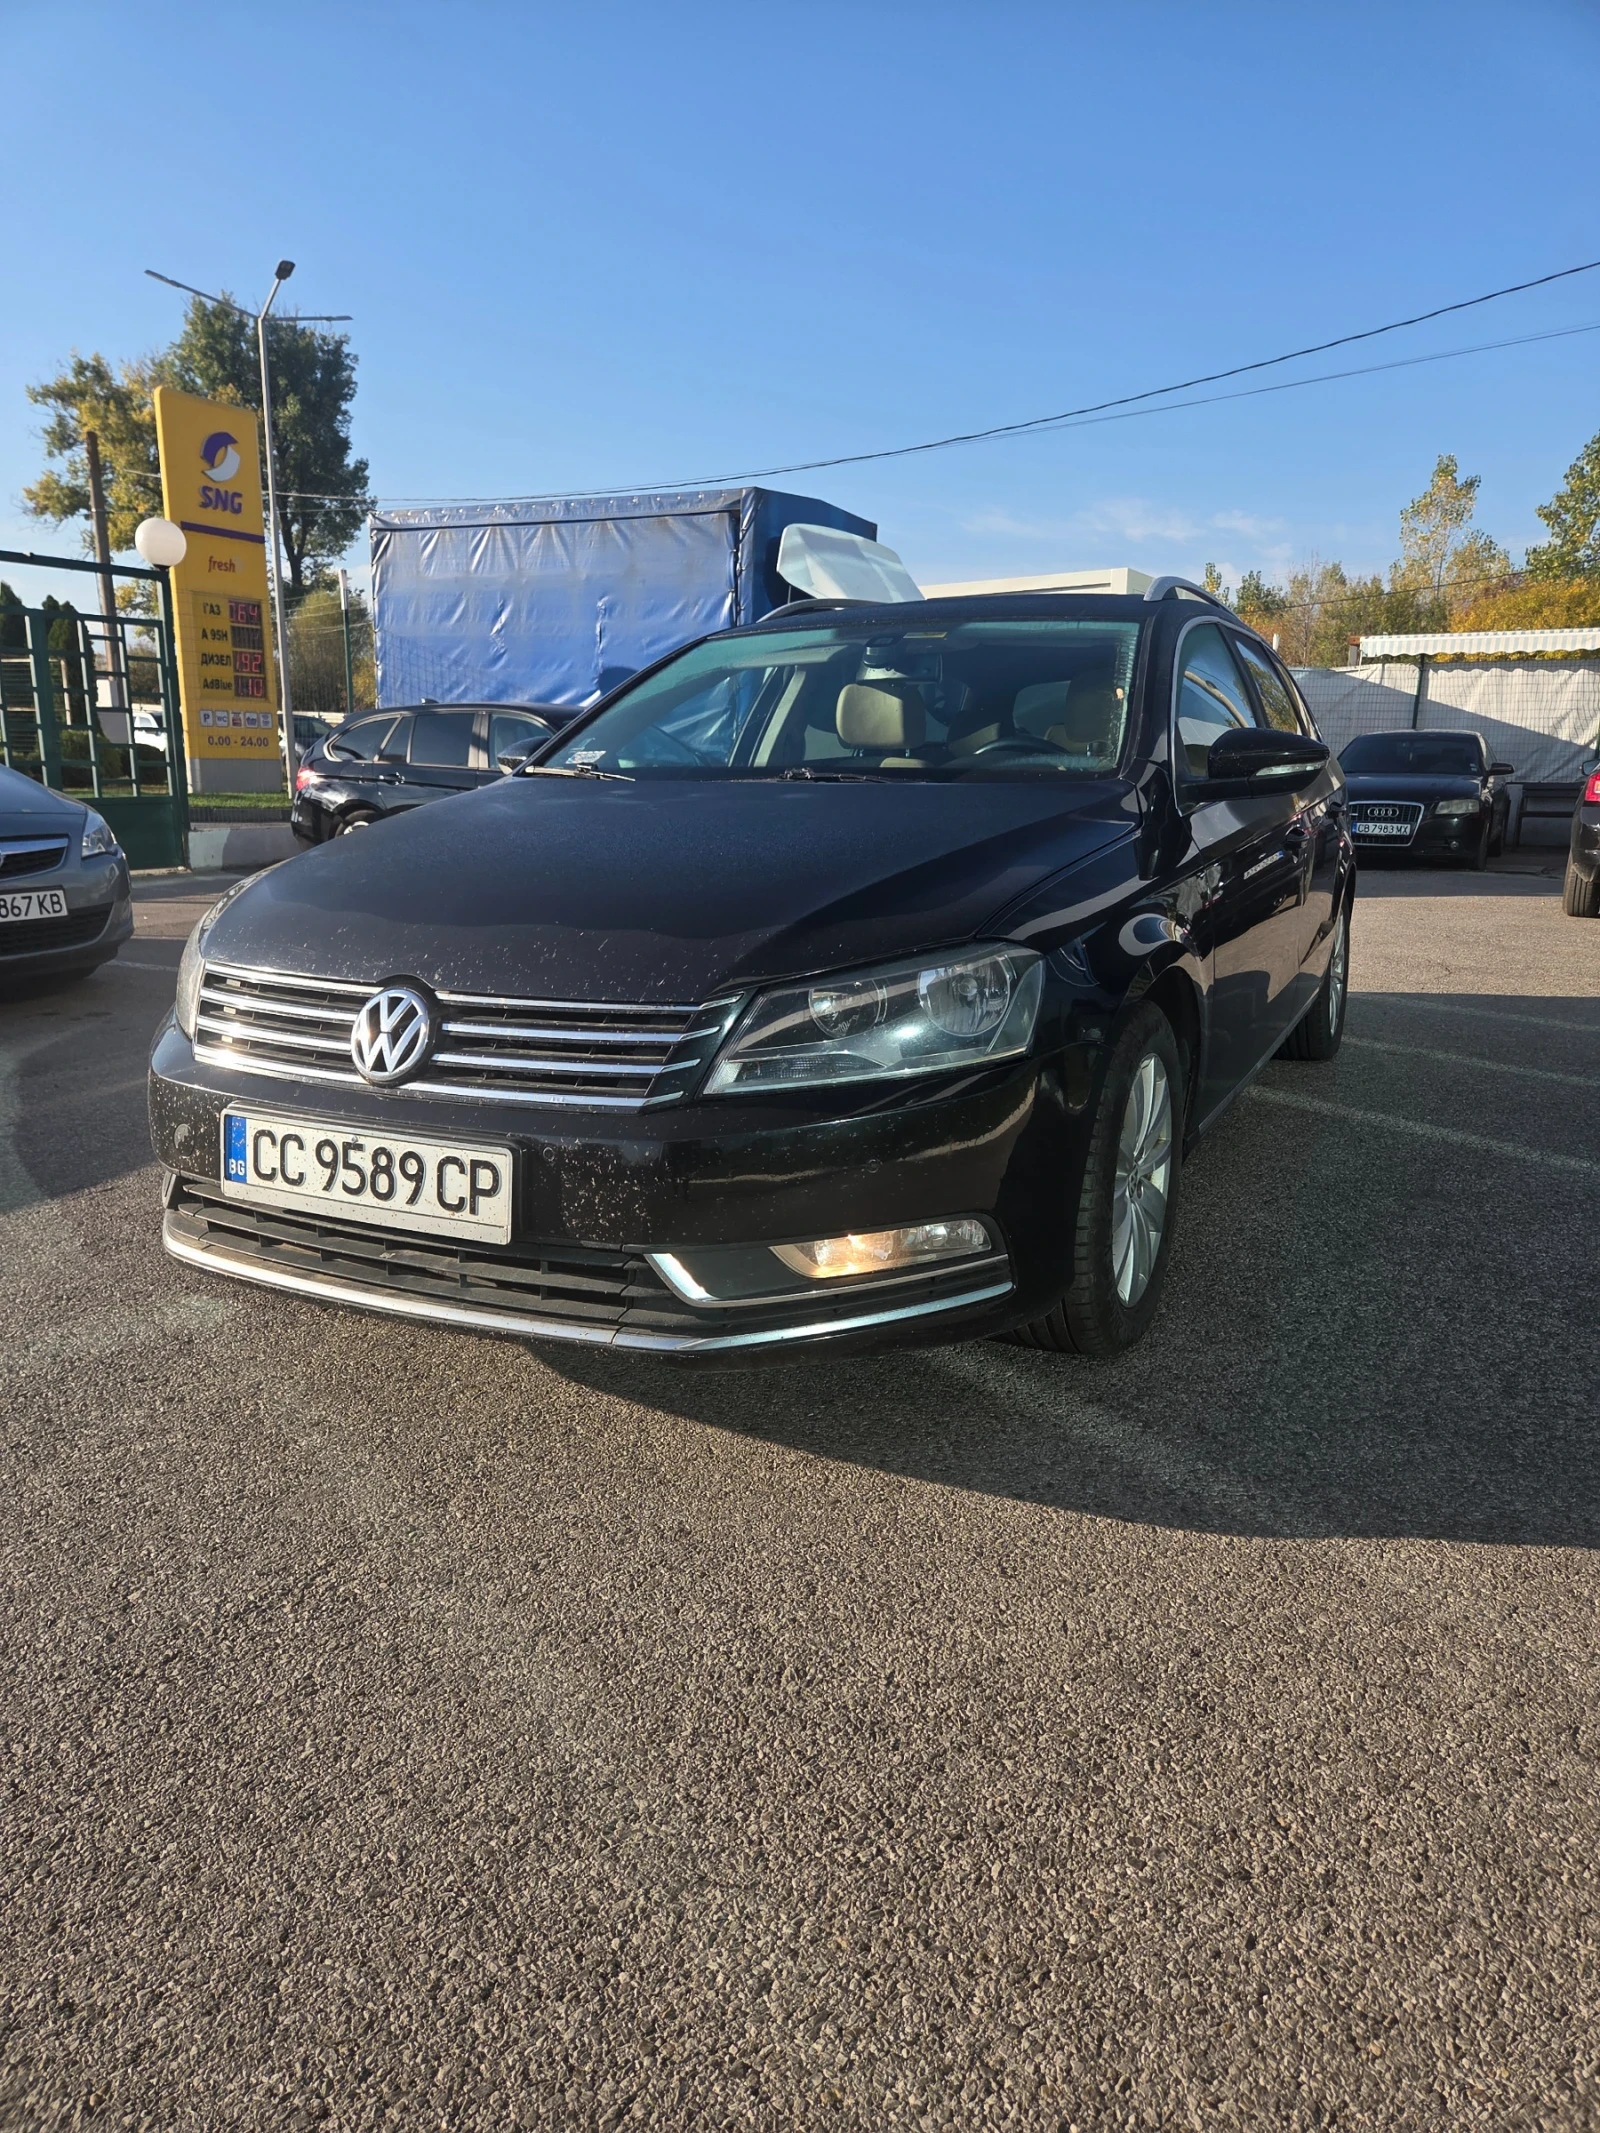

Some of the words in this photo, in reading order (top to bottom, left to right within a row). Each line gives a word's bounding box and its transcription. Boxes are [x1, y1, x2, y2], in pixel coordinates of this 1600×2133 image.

[199, 485, 243, 514] SNG
[208, 555, 236, 573] fresh
[203, 602, 221, 616] ГАЗ
[201, 653, 231, 667] ДИЗЕЛ
[203, 678, 232, 691] AdBlue
[207, 736, 231, 746] 0.00
[241, 736, 269, 747] 24.00
[1372, 824, 1395, 834] 7983
[37, 893, 63, 915] KB
[229, 1158, 245, 1176] BG
[252, 1129, 305, 1186] CC
[315, 1138, 426, 1206] 9589
[436, 1155, 501, 1215] CP
